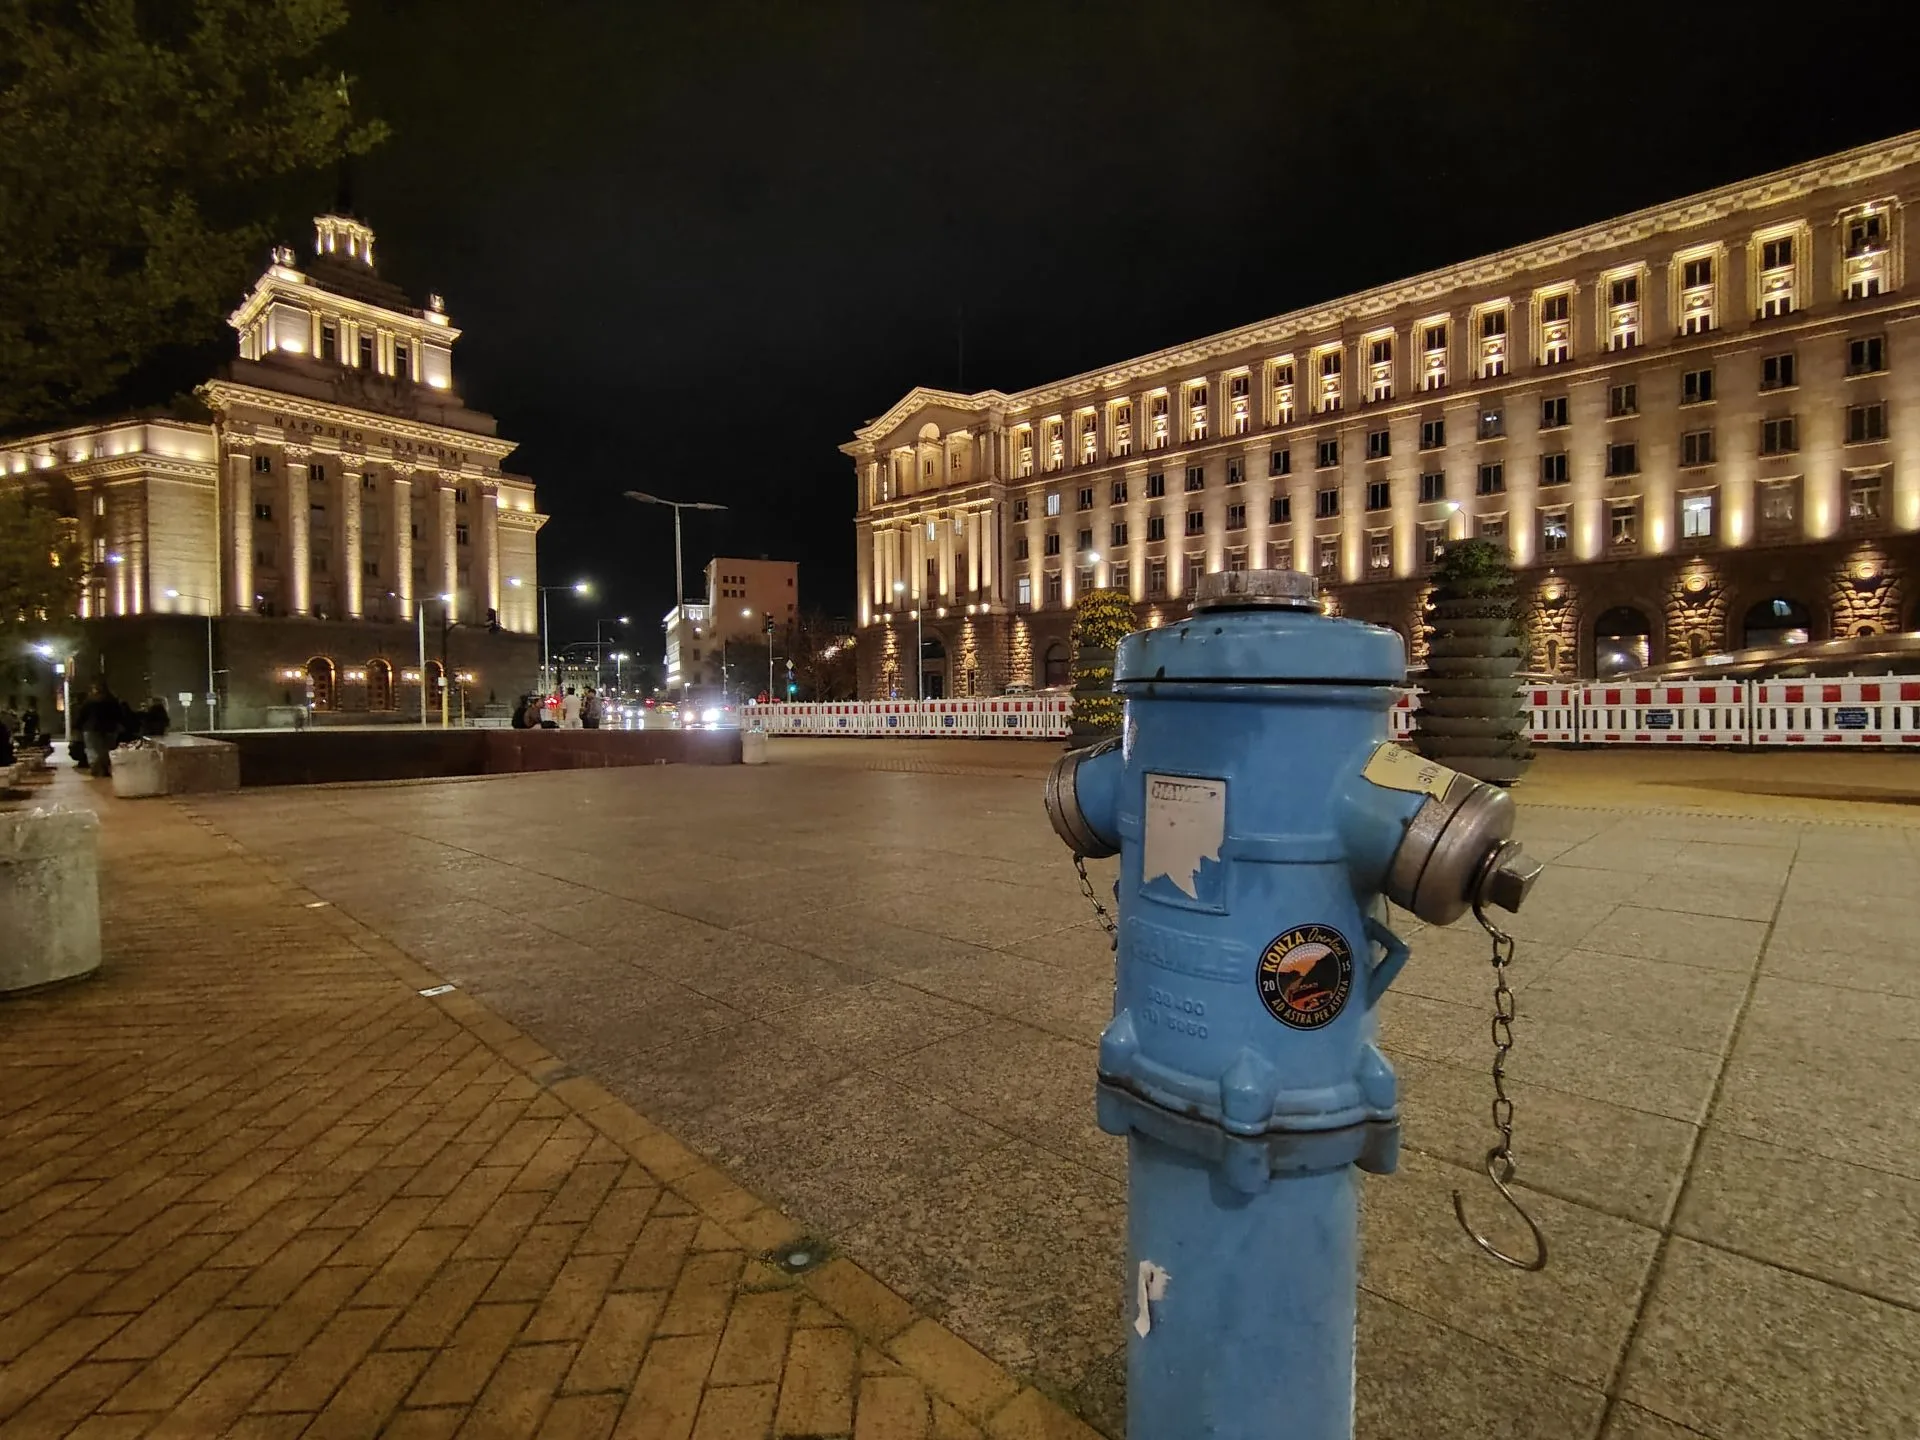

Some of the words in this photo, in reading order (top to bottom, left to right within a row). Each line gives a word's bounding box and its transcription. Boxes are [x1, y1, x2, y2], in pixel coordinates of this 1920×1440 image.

[274, 416, 363, 441] НАРОДНО
[1262, 930, 1306, 973] KONZA
[1262, 980, 1276, 992] 20
[1271, 999, 1286, 1012] AD
[1283, 1008, 1312, 1025] ASTRA
[1314, 1009, 1333, 1024] PER
[1330, 979, 1350, 1013] ASPERA
